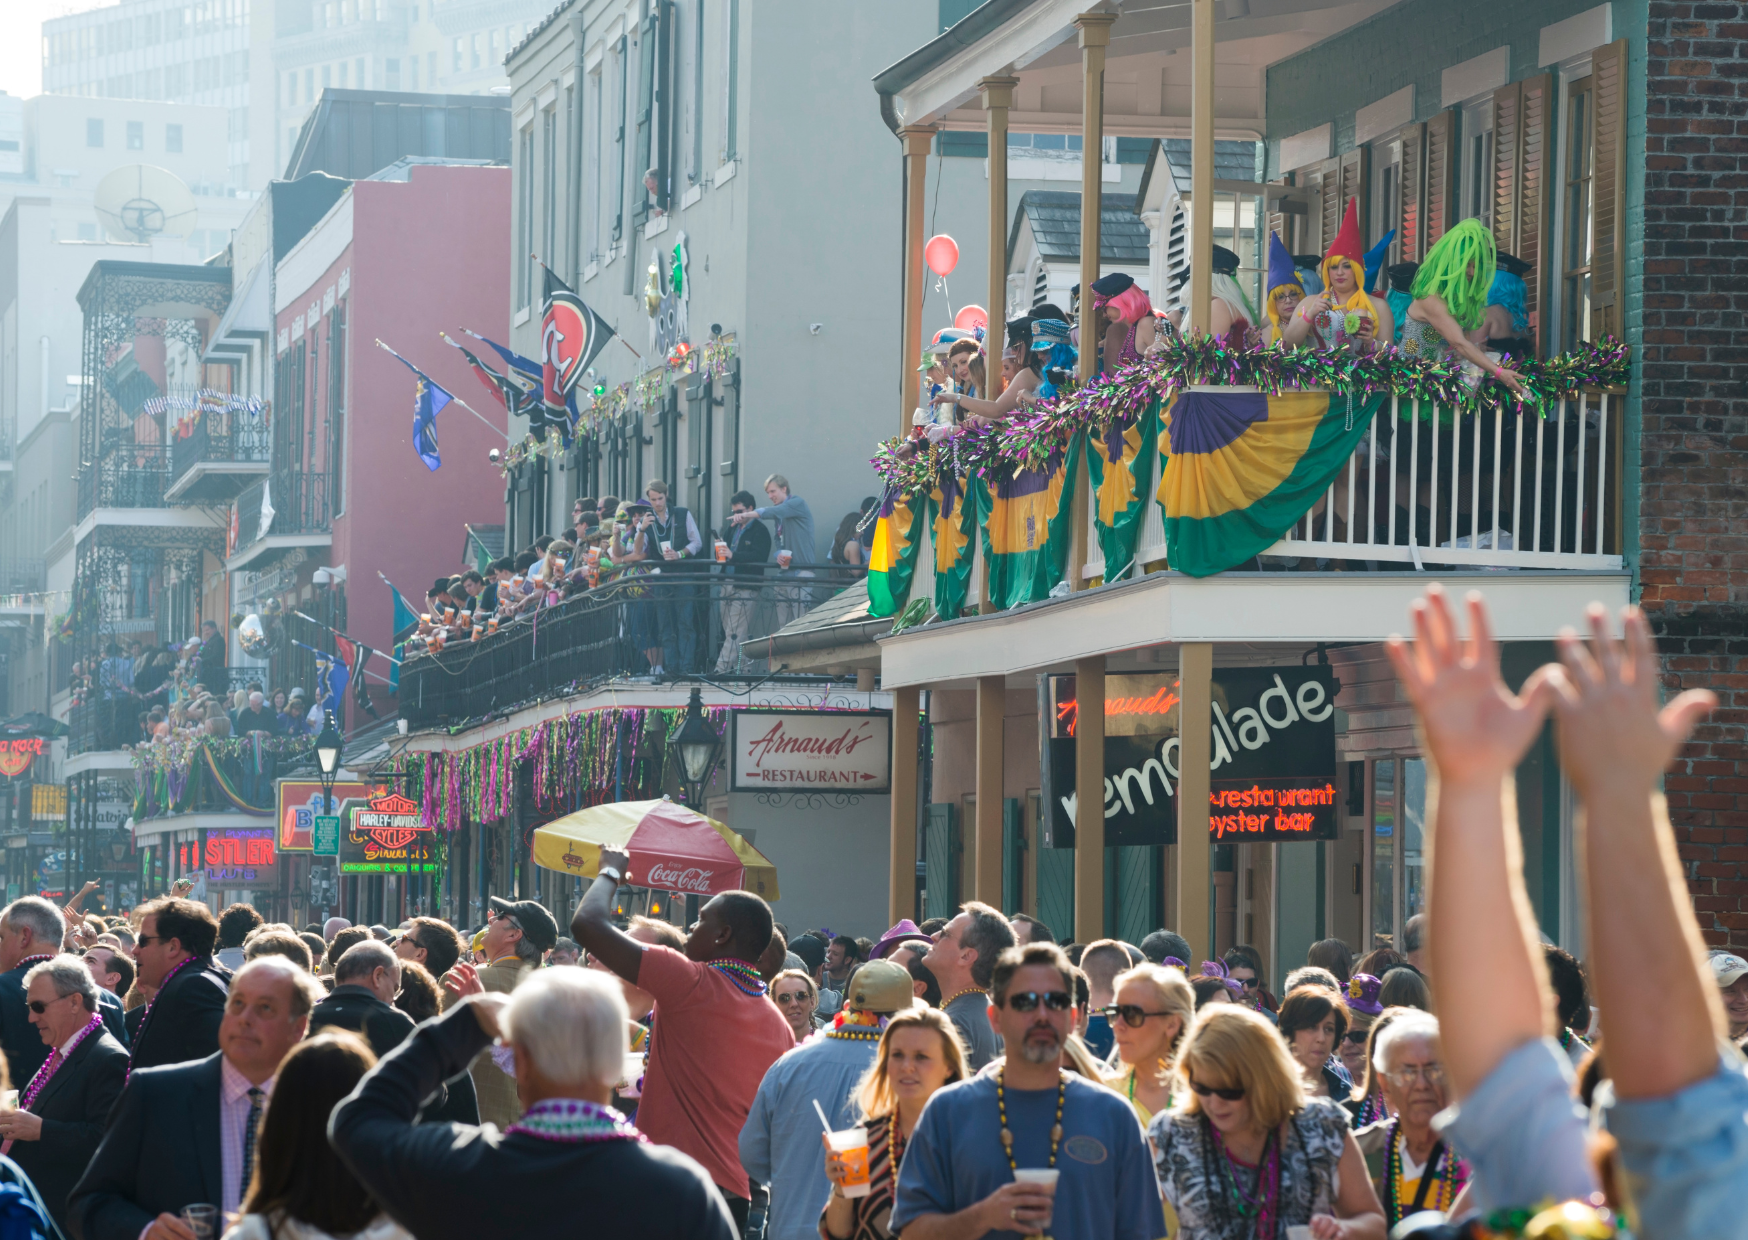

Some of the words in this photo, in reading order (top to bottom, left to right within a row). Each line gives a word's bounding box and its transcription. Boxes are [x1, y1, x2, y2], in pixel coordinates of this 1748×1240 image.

[1057, 680, 1180, 736] Aaud's
[748, 720, 873, 767] Arnaud's
[762, 769, 860, 783] RESTAURANT
[376, 797, 414, 812] MOTOR
[1220, 783, 1336, 808] restaurant
[360, 813, 426, 828] HARLEY-DAVIDSO
[1275, 807, 1315, 831] bar
[375, 830, 412, 846] CYCLES
[180, 838, 275, 866] STLER
[195, 868, 255, 880] LUB
[343, 864, 381, 872] DAIQUIRIS
[384, 863, 391, 872] &
[414, 864, 435, 872] BER
[647, 863, 714, 891] Coca-Cola
